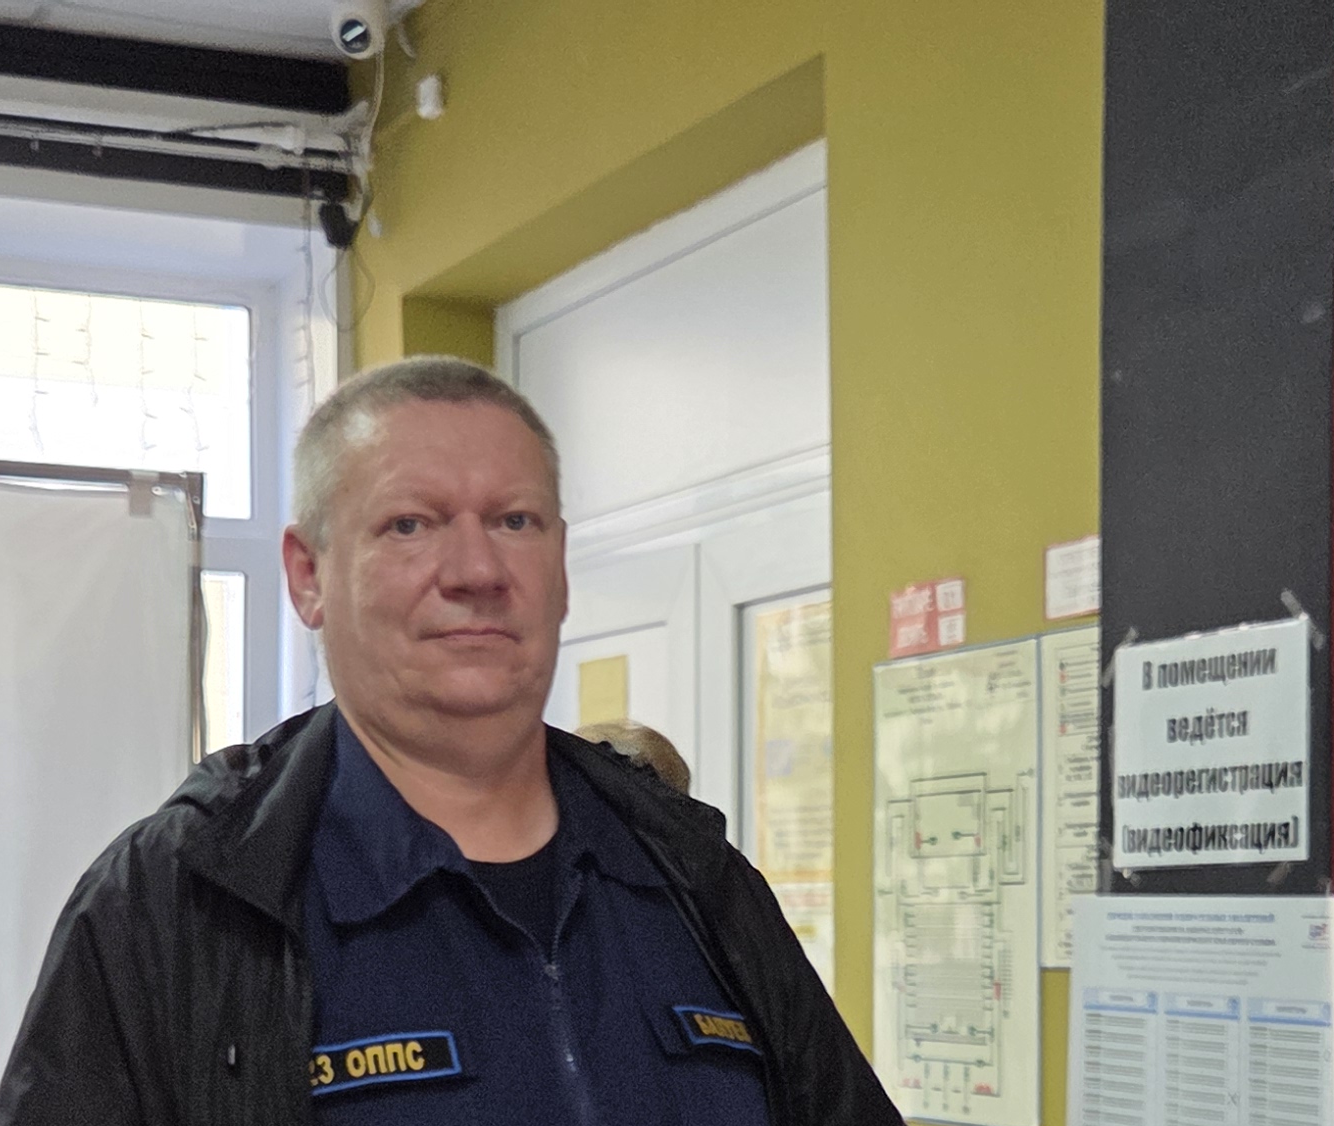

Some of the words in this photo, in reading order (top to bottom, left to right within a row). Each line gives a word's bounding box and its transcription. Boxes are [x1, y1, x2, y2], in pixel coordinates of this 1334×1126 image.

[1142, 660, 1153, 690] В
[1157, 648, 1277, 688] помещении
[1166, 707, 1249, 745] ведётся
[1117, 760, 1303, 802] видеорегистрация
[1122, 815, 1299, 857] (видеофиксация)
[346, 1041, 425, 1078] ОППС
